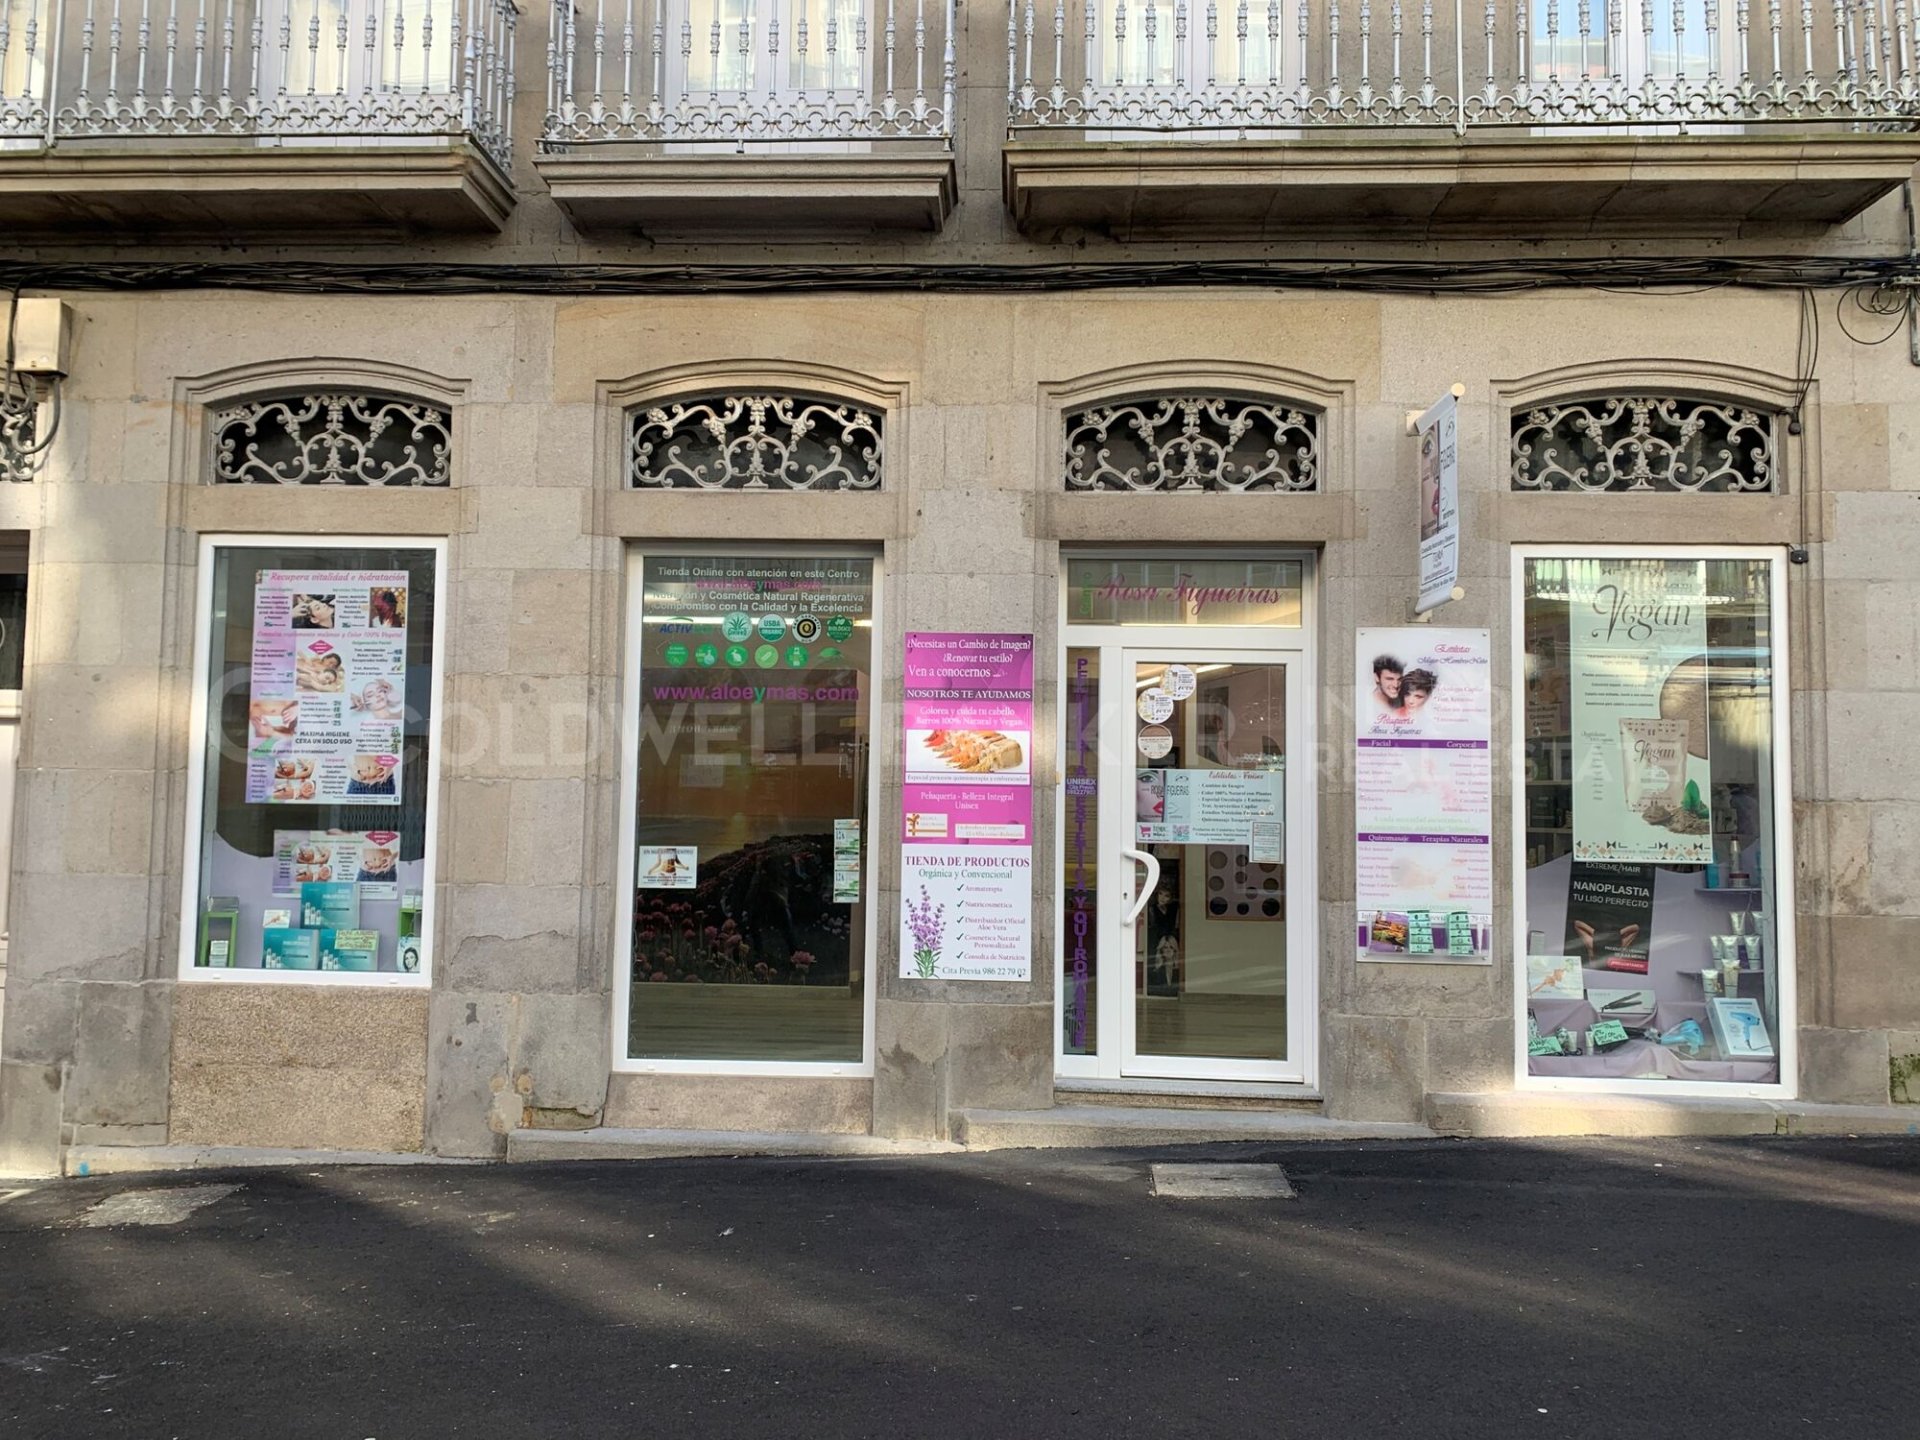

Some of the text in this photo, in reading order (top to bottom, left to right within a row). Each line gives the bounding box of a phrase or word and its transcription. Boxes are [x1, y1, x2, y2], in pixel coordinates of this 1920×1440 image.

[358, 571, 407, 582] hidratación
[658, 567, 690, 577] Tienda
[693, 567, 724, 577] Online
[746, 567, 787, 578] atención
[805, 569, 825, 578] este
[828, 568, 860, 579] Centro
[709, 591, 760, 601] Cosmética
[763, 592, 799, 601] Natural
[801, 593, 865, 603] Regenerativa
[1098, 572, 1282, 616] Rosa Figueiras
[653, 601, 717, 612] Compromiso
[740, 602, 749, 611] la
[752, 602, 788, 612] Calidad
[790, 605, 797, 614] y
[799, 603, 808, 612] la
[811, 603, 863, 613] Excelencia
[1591, 584, 1691, 643] Vegan
[907, 639, 1031, 651] ¿Necesitas un Cambio de Imagen?
[943, 653, 1014, 663] ¿Renovar tu estilo?
[908, 665, 991, 677] Ven a conocernos
[653, 684, 859, 704] www.aloeymas.com
[907, 690, 1031, 699] NOSOTROS TE AYUDAMOS
[1066, 778, 1097, 786] UNISEX
[905, 856, 1030, 868] TIENDA DE PRODUCTOS
[919, 868, 1013, 880] Orgánica y Convencional
[1573, 881, 1650, 897] NANOPLASTIA
[1573, 893, 1649, 909] TU LISO PERFECTO
[942, 966, 958, 974] Cita
[959, 966, 981, 975] Previa
[982, 967, 996, 975] 986
[997, 967, 1007, 975] 22
[1007, 967, 1016, 976] 79
